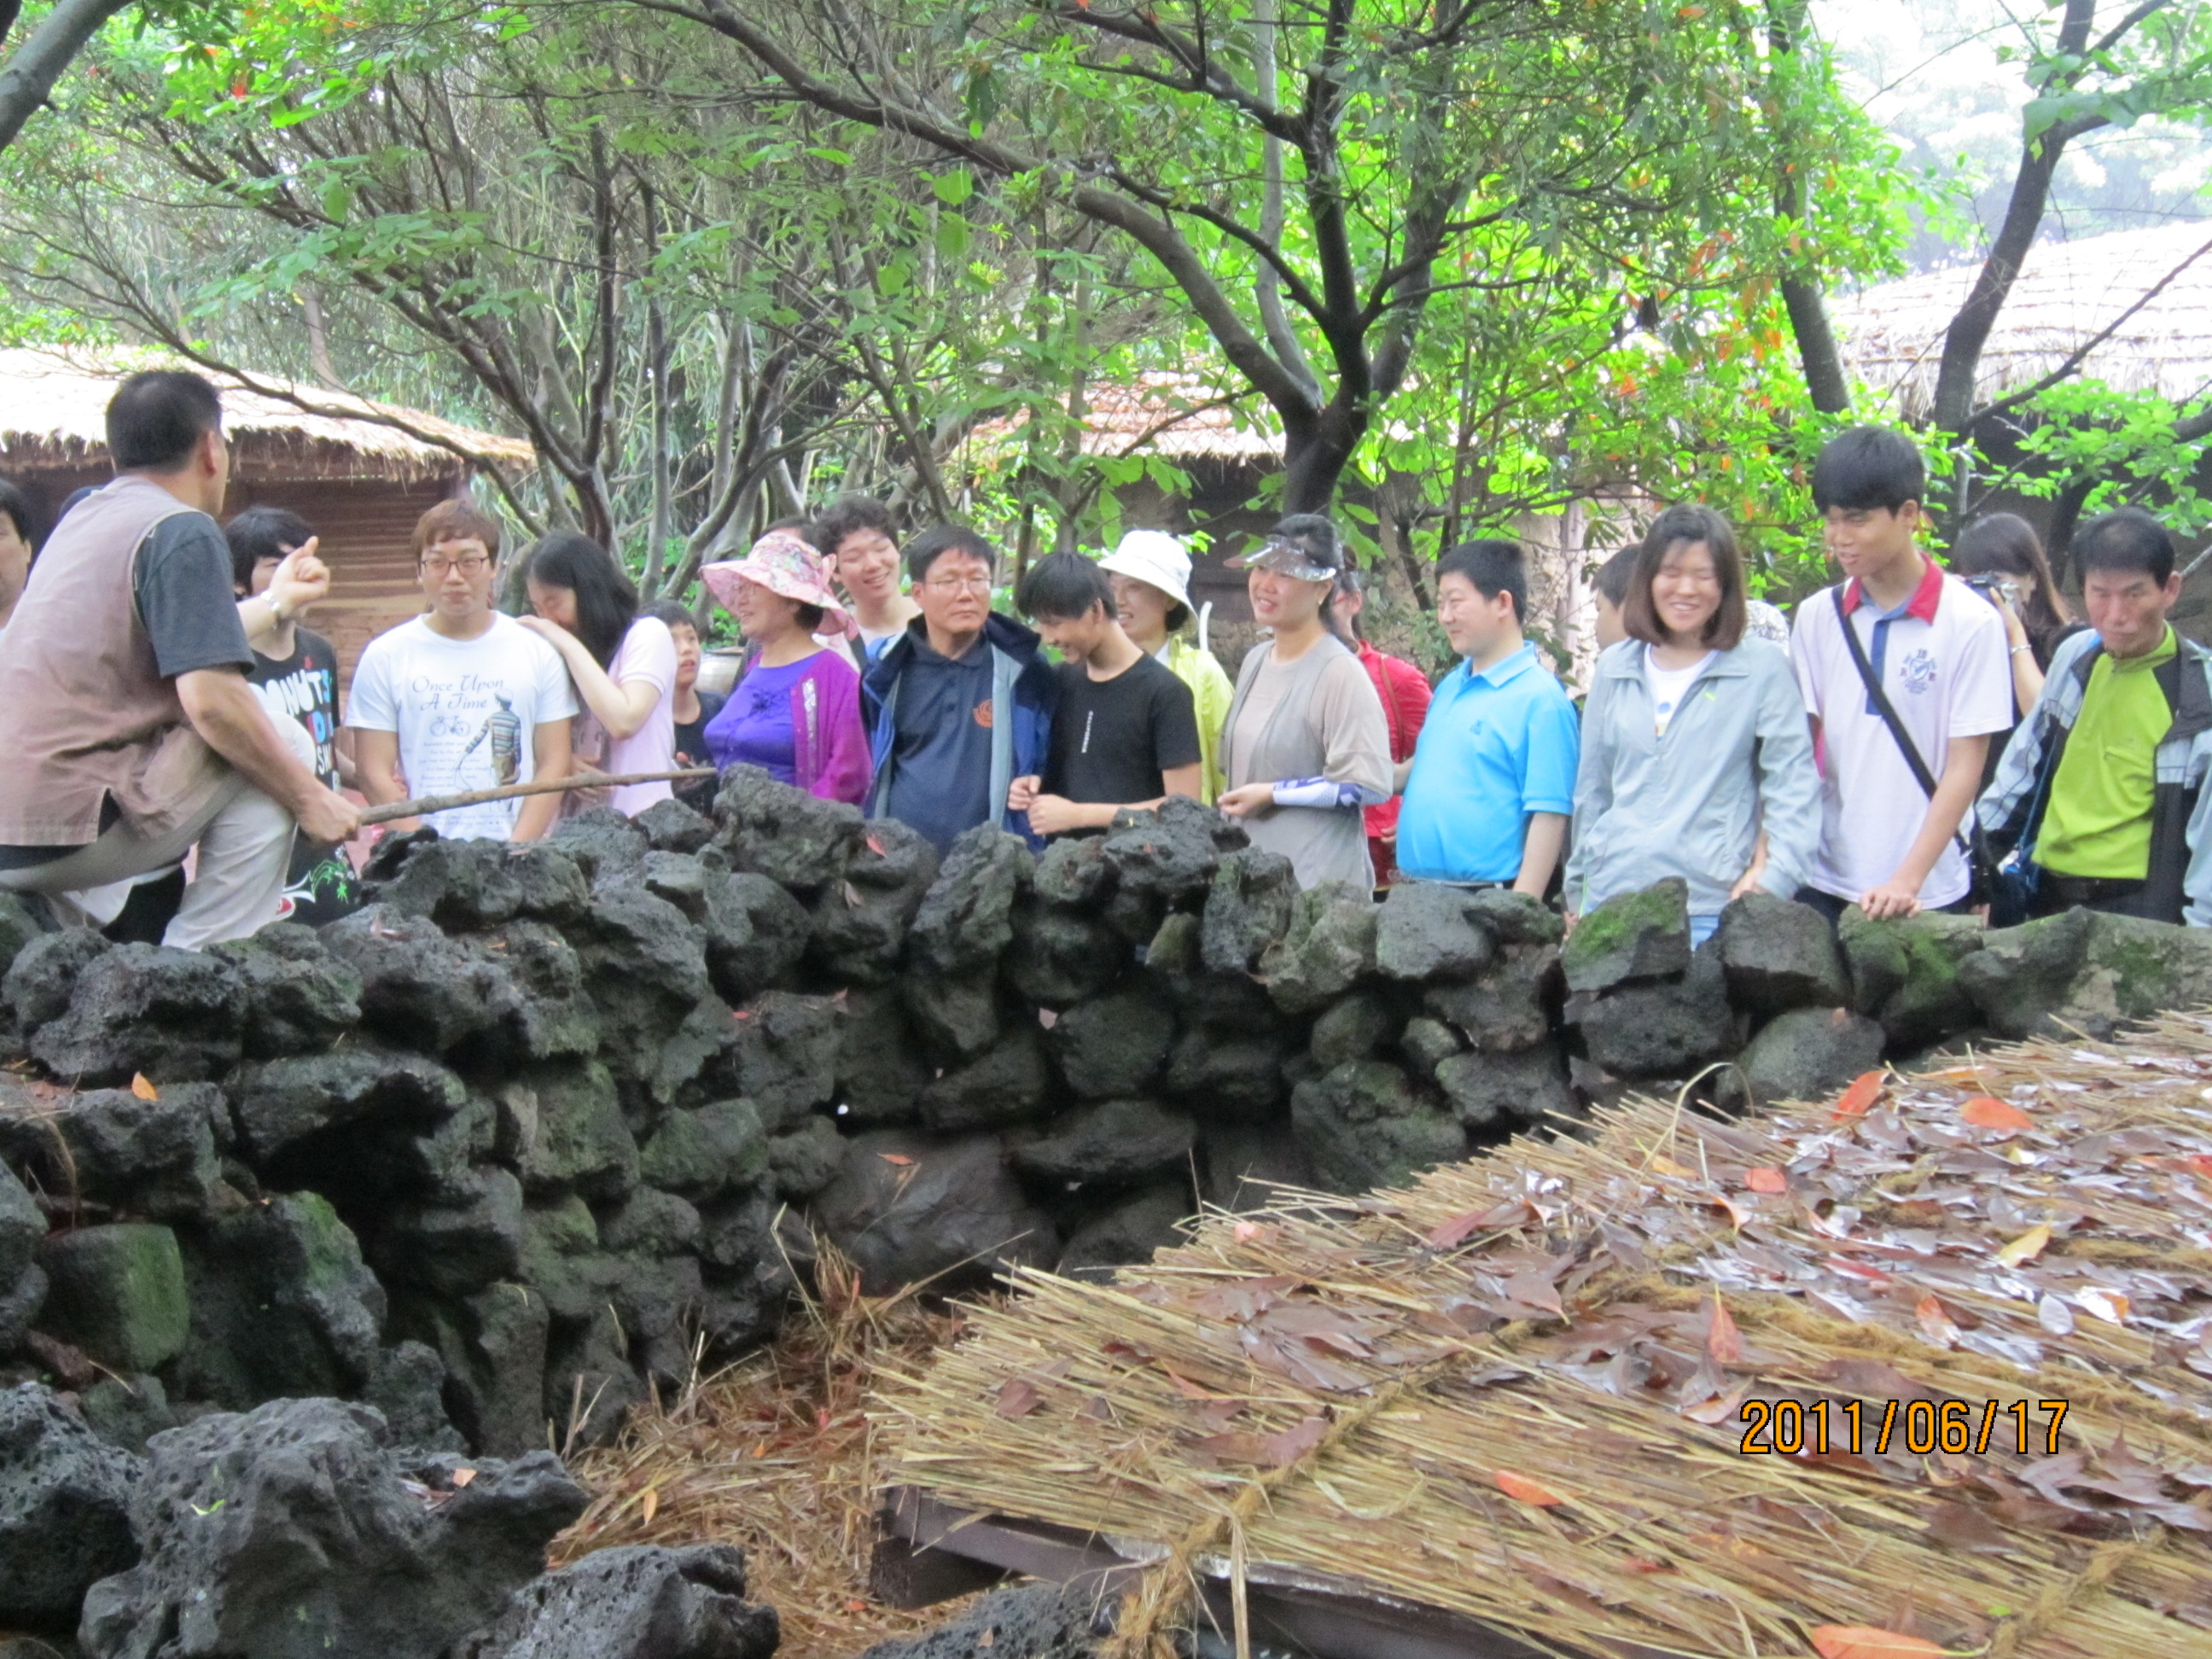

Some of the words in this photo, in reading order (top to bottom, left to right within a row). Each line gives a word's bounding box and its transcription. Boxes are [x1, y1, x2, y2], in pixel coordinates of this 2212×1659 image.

[412, 676, 452, 693] Once
[460, 673, 504, 694] Upon
[420, 692, 439, 711] A
[447, 692, 487, 710] Time
